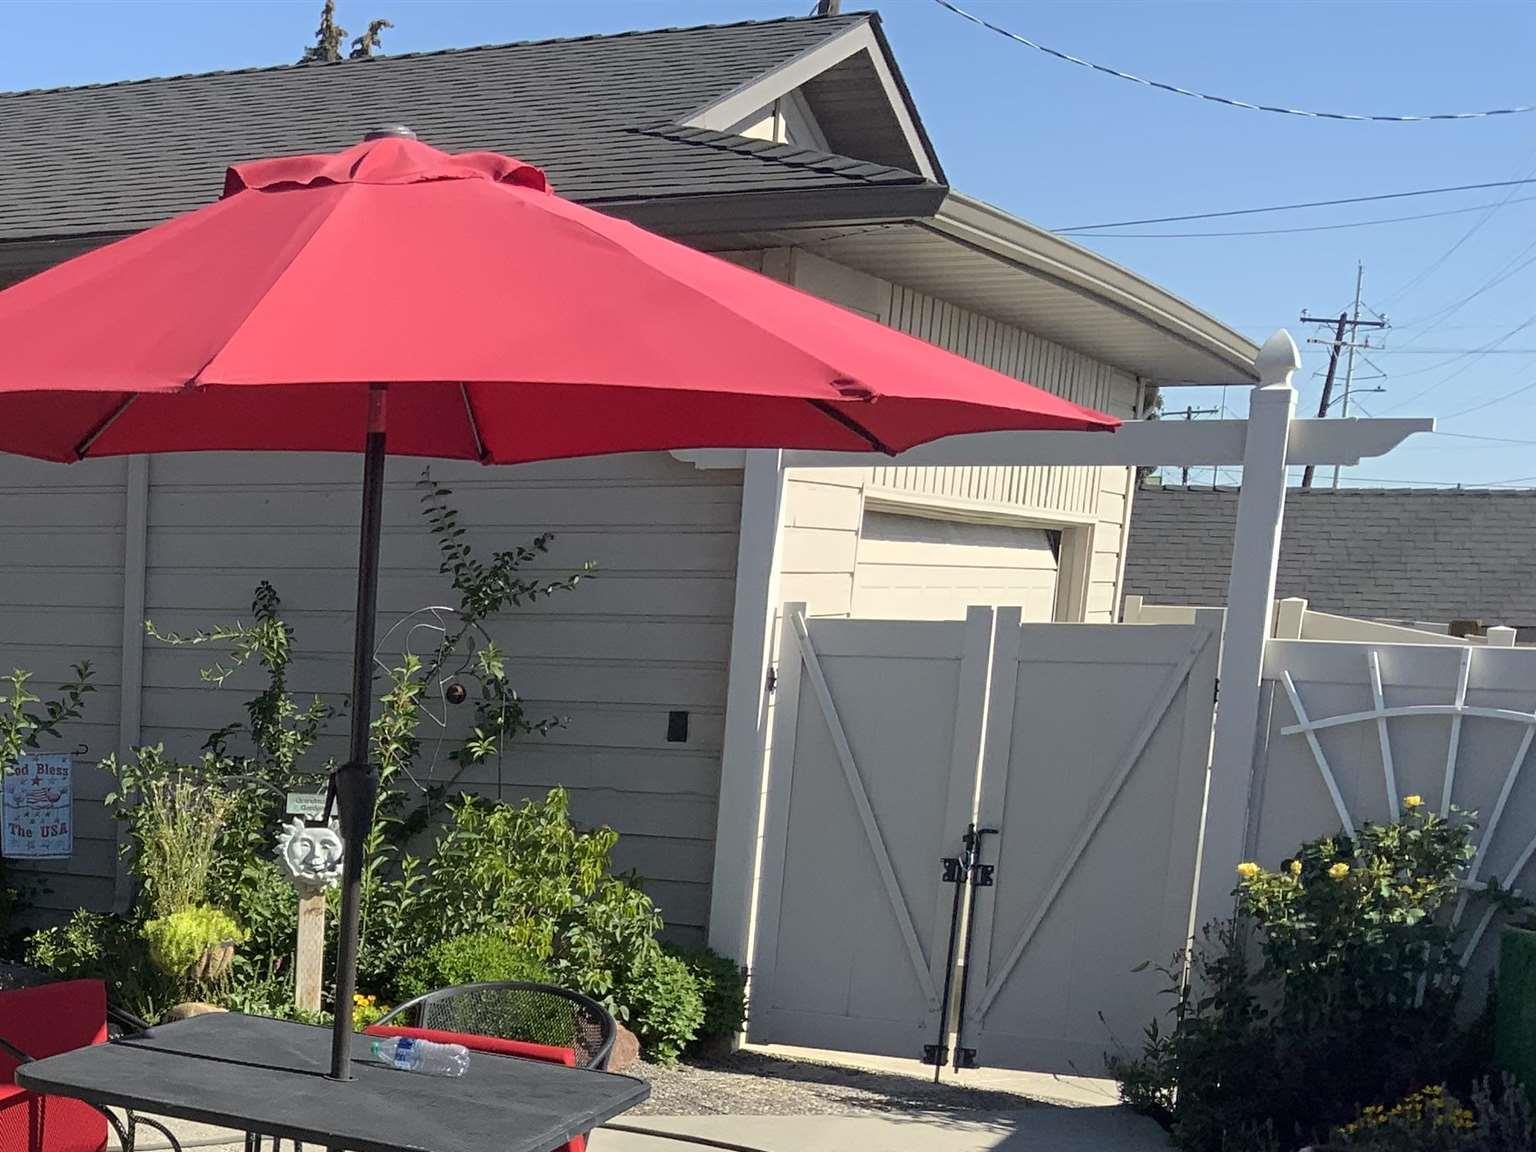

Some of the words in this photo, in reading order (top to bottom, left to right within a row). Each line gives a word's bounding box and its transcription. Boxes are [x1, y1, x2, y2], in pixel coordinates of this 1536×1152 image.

[37, 763, 69, 776] Bless
[8, 822, 32, 837] The
[40, 822, 68, 838] USA
